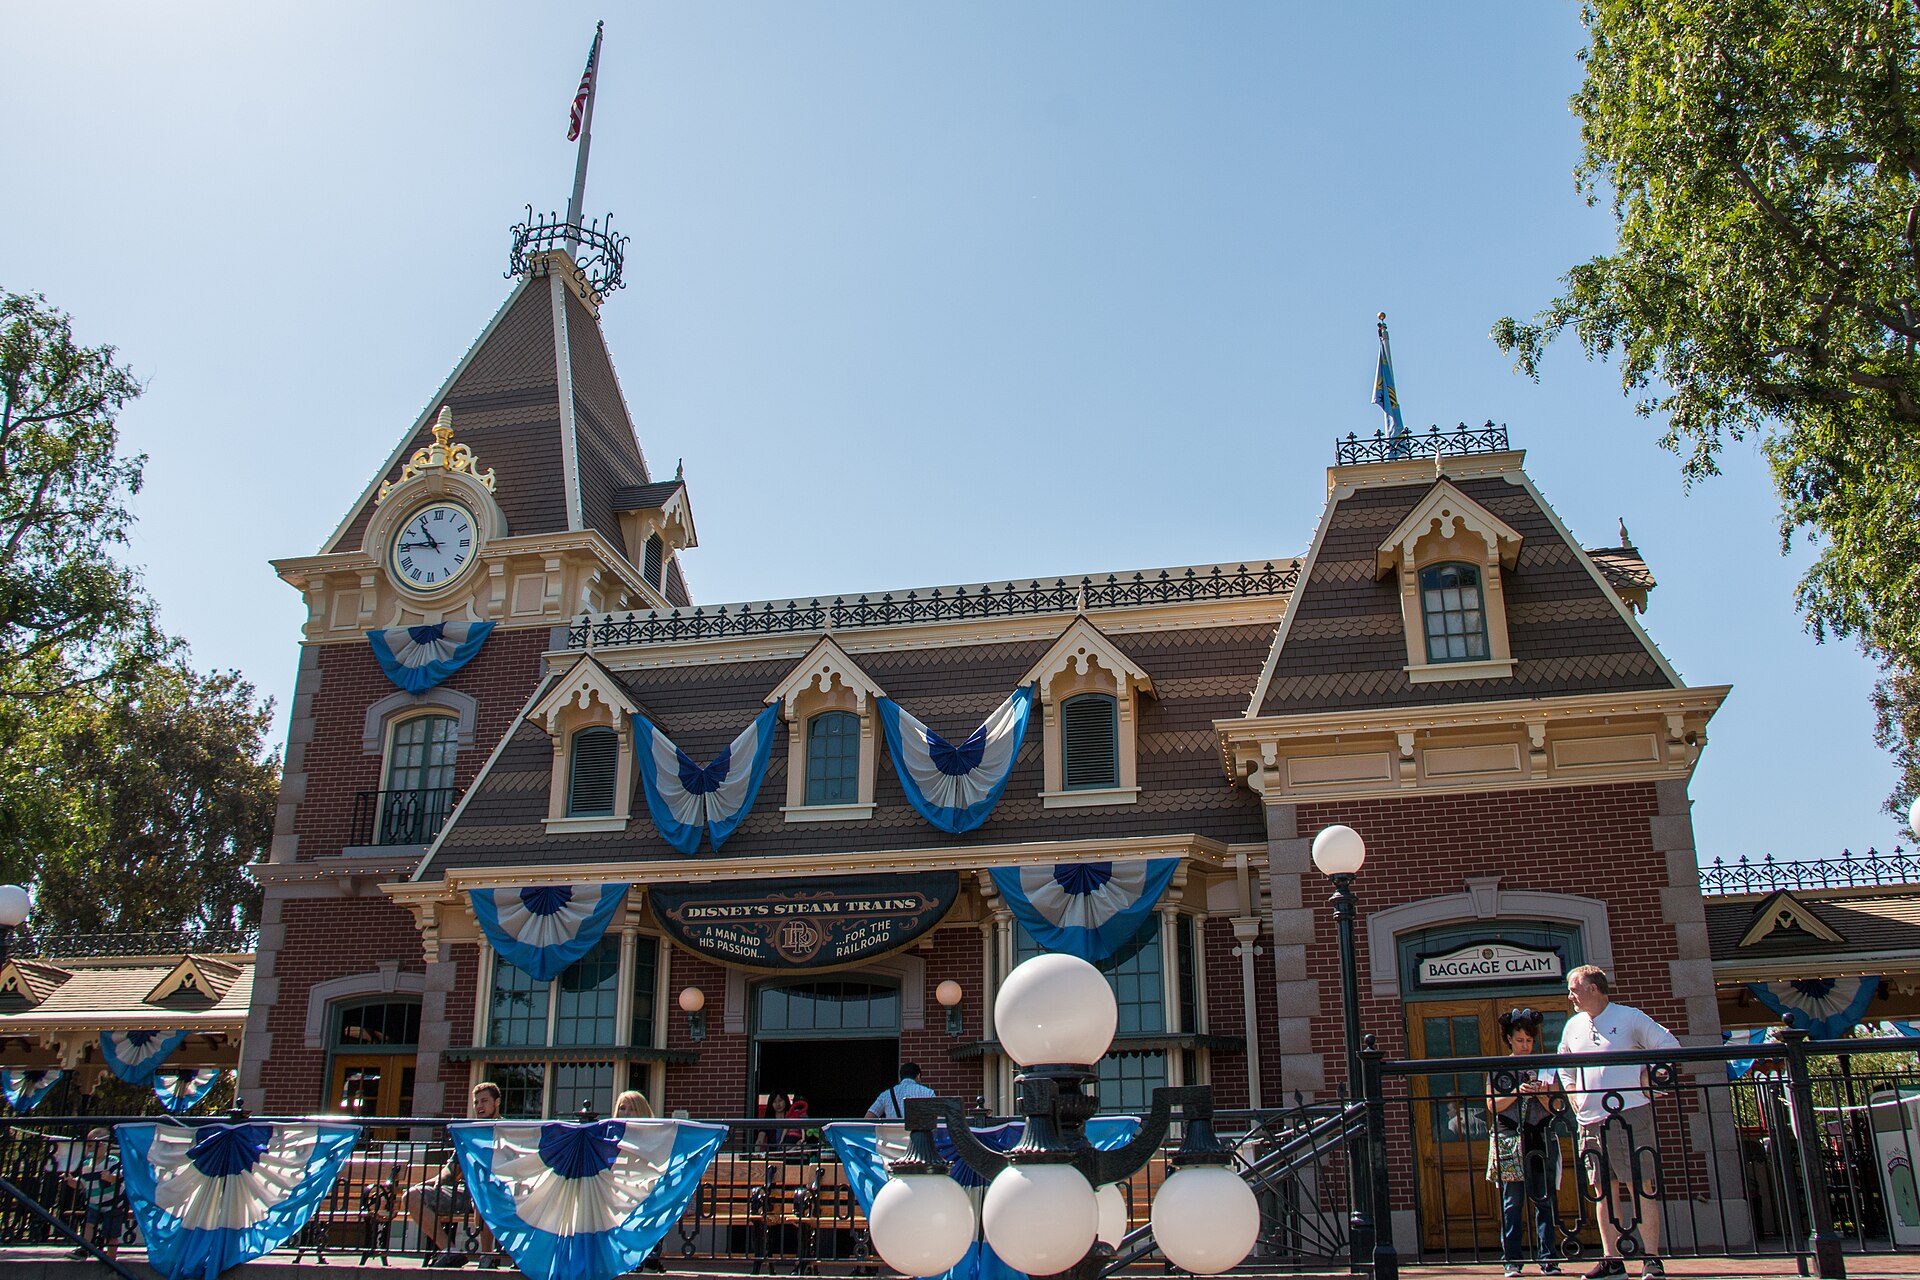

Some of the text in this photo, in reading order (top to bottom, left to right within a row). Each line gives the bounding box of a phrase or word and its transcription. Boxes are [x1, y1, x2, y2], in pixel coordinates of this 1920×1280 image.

[419, 515, 428, 525] XI
[433, 510, 444, 520] XII
[687, 898, 916, 918] DISNEY'S STEAM TRAINS
[869, 919, 891, 933] THE
[705, 926, 761, 947] A MAN AND
[836, 932, 890, 957] RAILROAD
[699, 937, 766, 959] HIS PASSION...
[1428, 958, 1552, 977] BAGGAGE CLAIM
